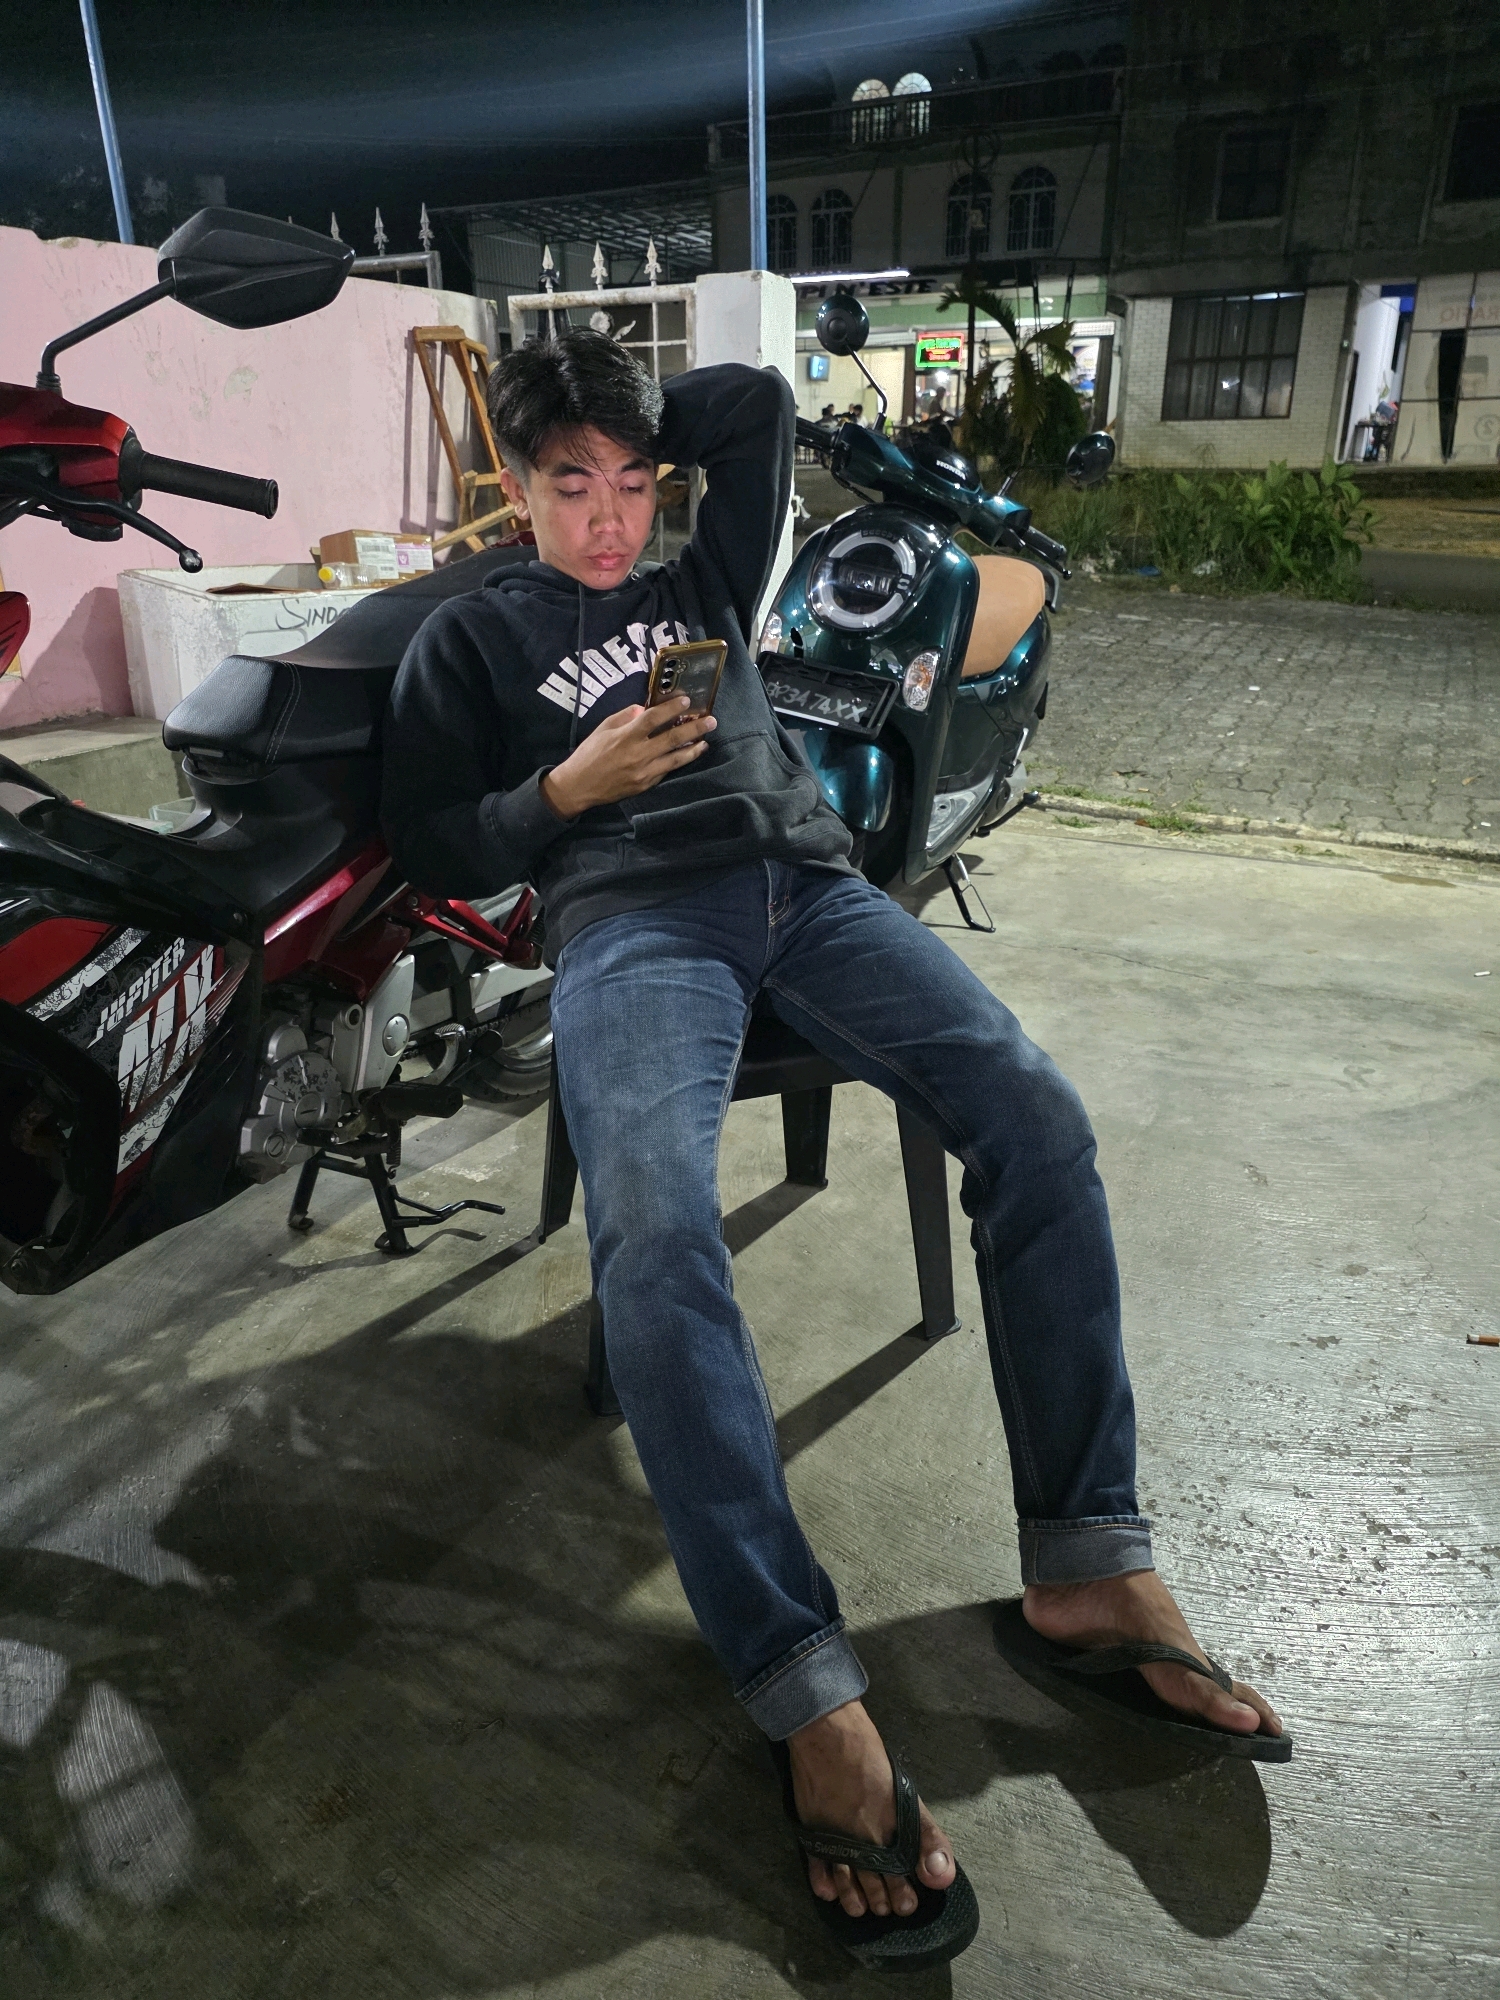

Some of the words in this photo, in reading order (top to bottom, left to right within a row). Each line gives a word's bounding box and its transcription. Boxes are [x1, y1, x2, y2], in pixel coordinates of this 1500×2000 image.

[936, 459, 966, 481] HONDA
[86, 937, 186, 1049] JUPITER
[117, 944, 215, 1112] MX
[814, 1841, 861, 1858] Swallow
